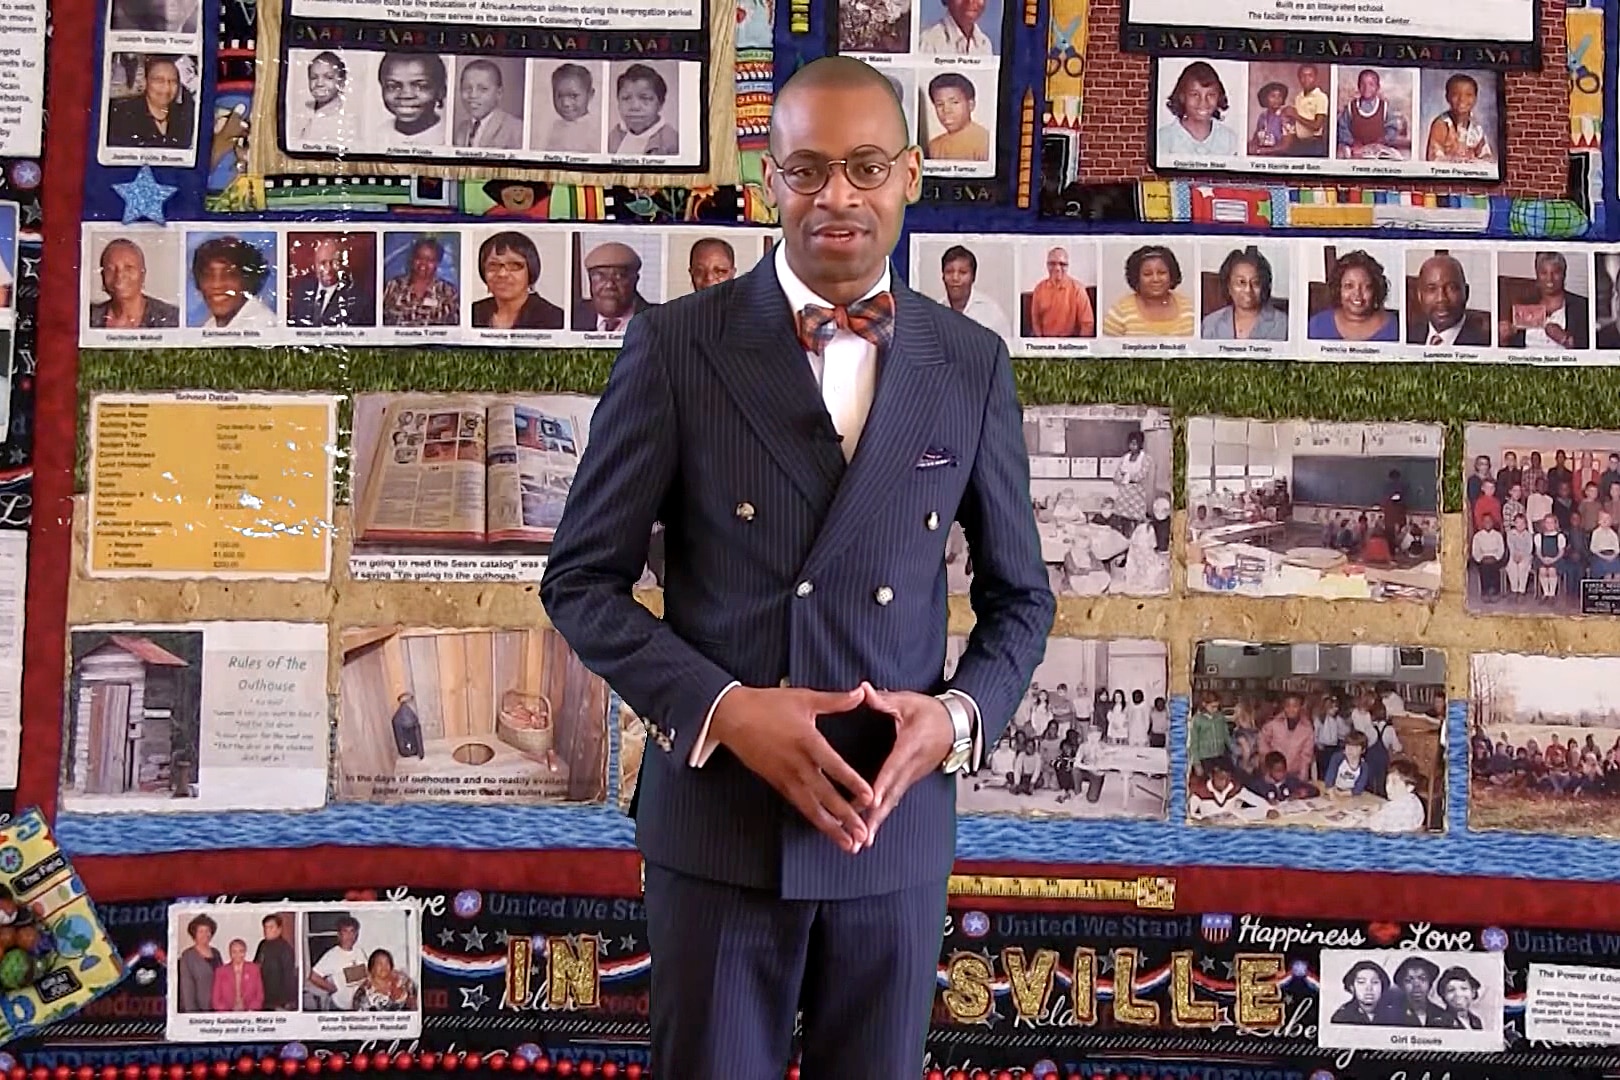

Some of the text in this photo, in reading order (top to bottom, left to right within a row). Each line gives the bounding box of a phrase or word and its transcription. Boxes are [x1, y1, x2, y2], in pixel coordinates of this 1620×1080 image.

[387, 9, 401, 18] The
[403, 10, 428, 19] facility
[539, 15, 582, 26] Community
[1249, 12, 1262, 20] The
[1263, 12, 1289, 21] facility
[1354, 16, 1383, 24] Science
[175, 393, 239, 402] School Details
[369, 559, 396, 570] going
[451, 559, 477, 568] Sears
[360, 572, 391, 581] saying
[415, 572, 441, 581] going
[228, 655, 307, 671] Rules of the
[238, 679, 296, 693] Outhouse
[374, 774, 396, 784] days
[411, 775, 460, 784] outhouses
[463, 776, 481, 784] and
[498, 776, 529, 786] readily
[427, 788, 450, 796] cobs
[488, 894, 565, 917] United
[571, 897, 605, 919] We
[997, 913, 1193, 939] United We Stand
[1237, 914, 1475, 952] Happiness Love
[1514, 930, 1594, 955] United
[505, 933, 601, 1010] IN
[1538, 969, 1554, 978] The
[1556, 970, 1586, 980] Power
[1589, 972, 1598, 980] of
[943, 947, 1286, 1030] SVILLE
[1390, 1035, 1443, 1046] Girl Scouts
